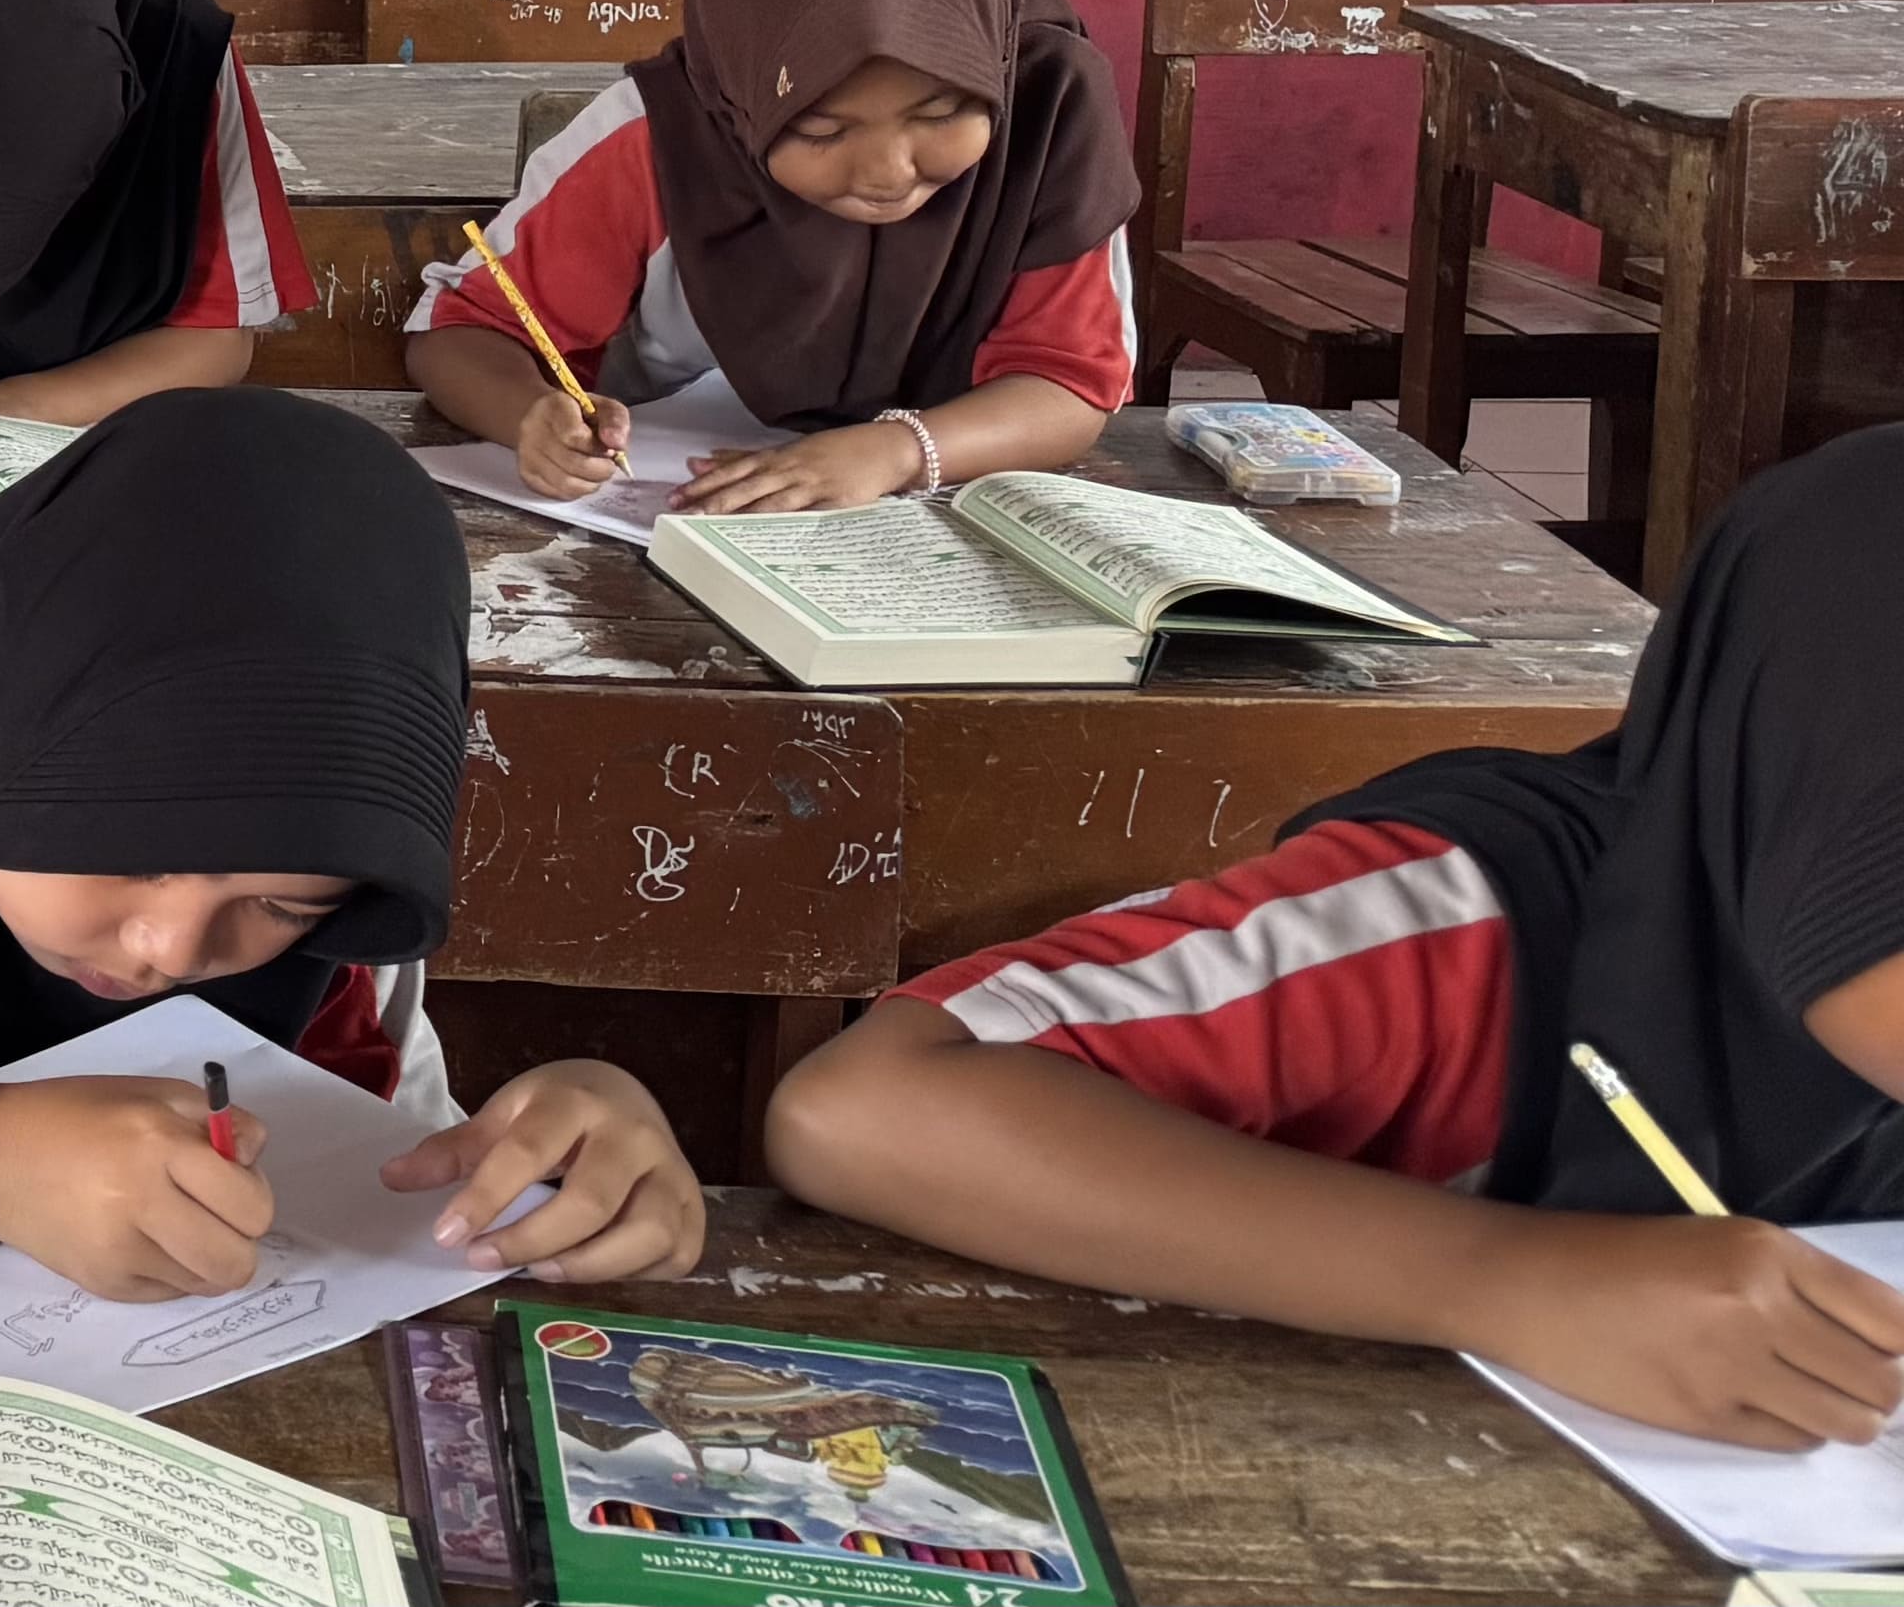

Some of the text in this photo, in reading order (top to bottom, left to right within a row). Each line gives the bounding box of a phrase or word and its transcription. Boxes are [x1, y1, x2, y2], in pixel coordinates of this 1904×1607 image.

[641, 1553, 734, 1577] Pencils
[741, 1564, 819, 1585] Color
[824, 1574, 953, 1605] Woodless
